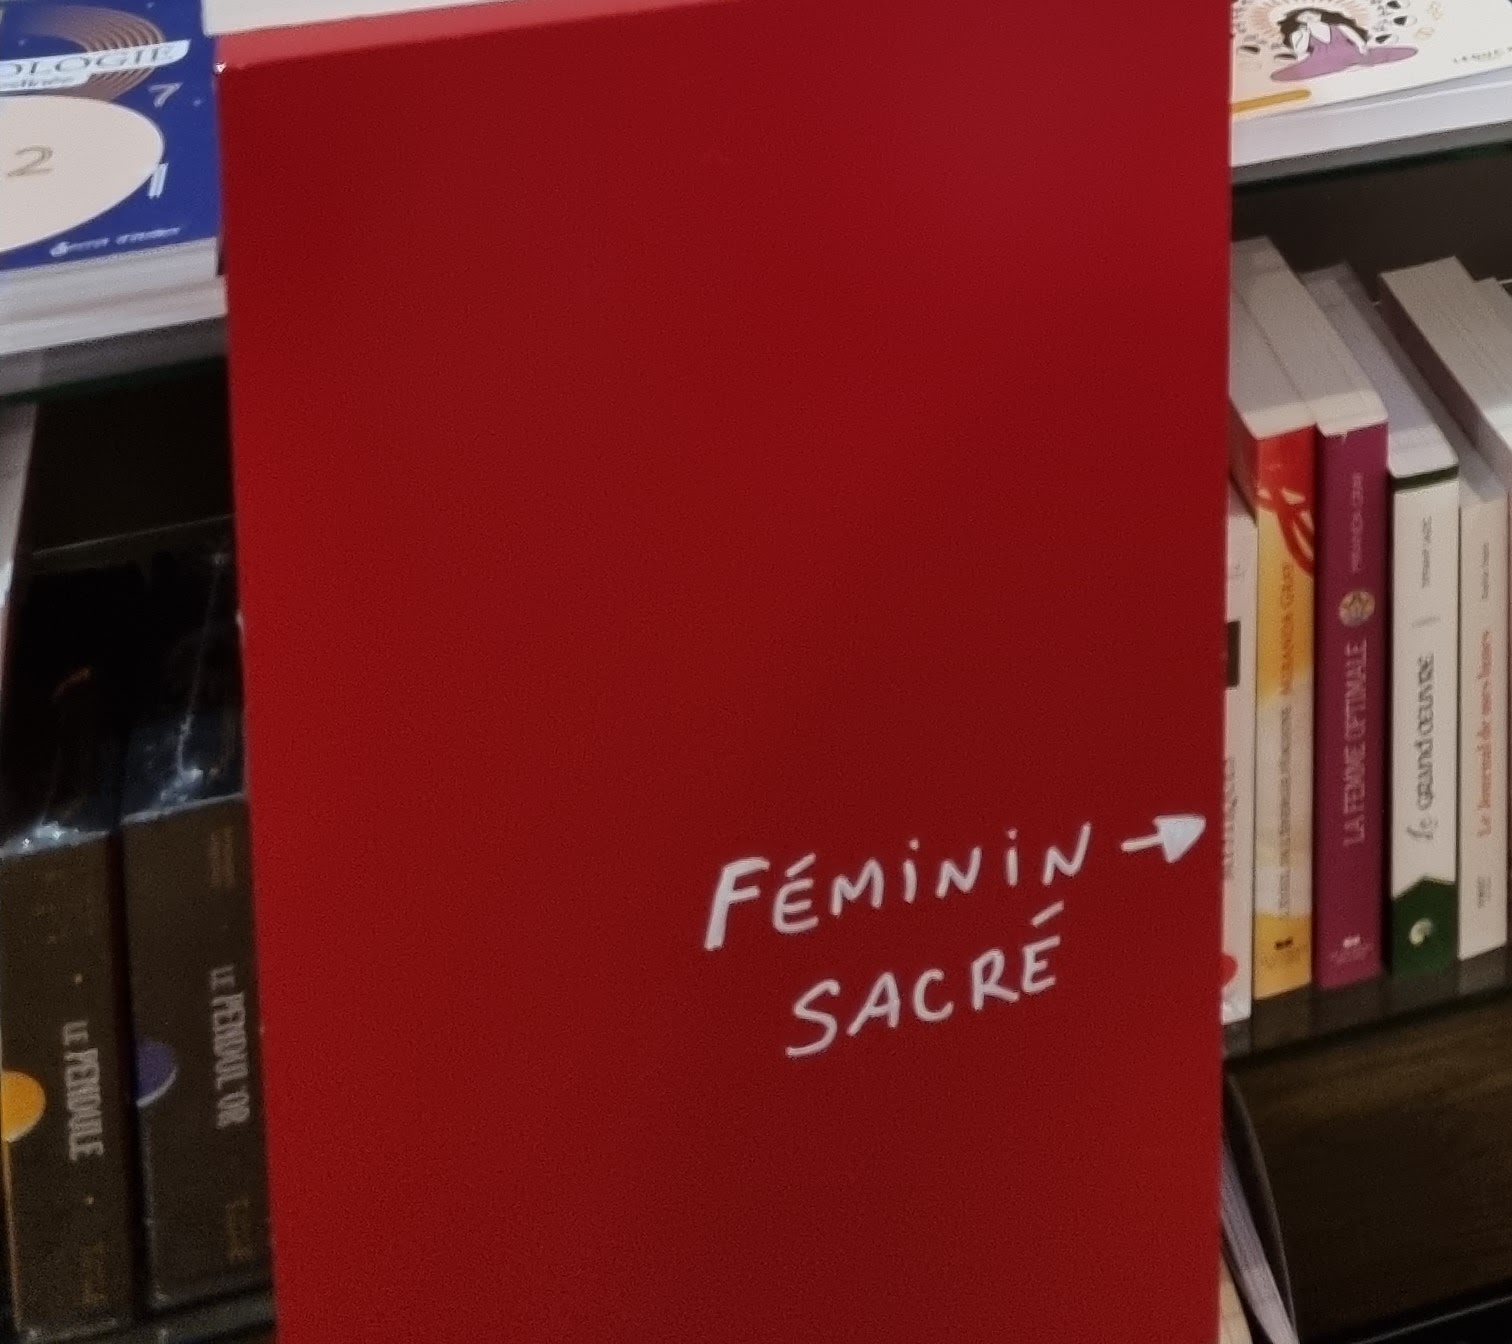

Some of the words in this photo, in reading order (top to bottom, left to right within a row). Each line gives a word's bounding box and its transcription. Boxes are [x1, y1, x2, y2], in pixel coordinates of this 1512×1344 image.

[1344, 639, 1369, 738] OPTIMALE
[1344, 740, 1367, 813] FEMME
[1344, 815, 1367, 845] LA
[209, 965, 237, 989] LE
[786, 901, 1065, 1058] SACRÉ
[62, 1020, 90, 1045] LE
